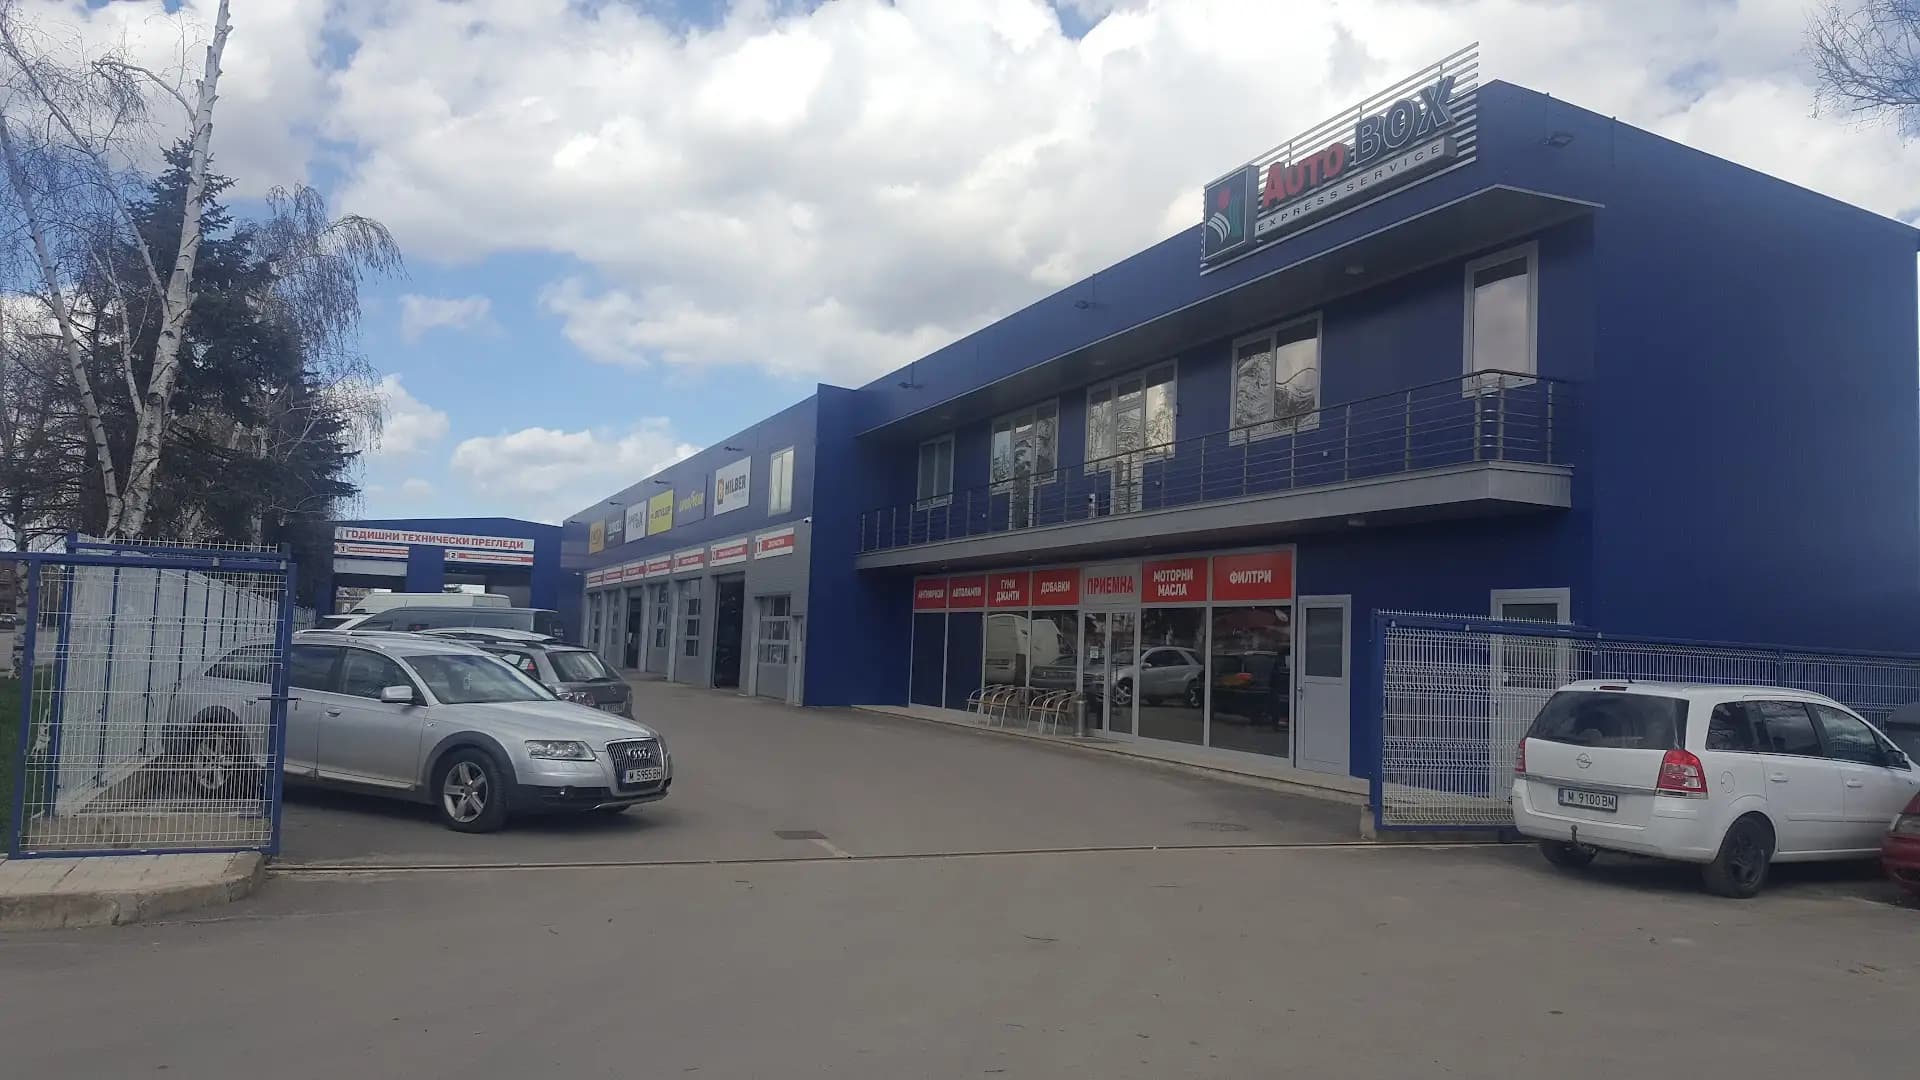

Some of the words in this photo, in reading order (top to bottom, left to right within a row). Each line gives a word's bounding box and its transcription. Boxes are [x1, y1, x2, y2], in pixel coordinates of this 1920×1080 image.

[1354, 75, 1457, 166] BOX
[1257, 190, 1338, 232] EXPRESS
[1346, 143, 1441, 192] SERVICE
[345, 529, 400, 541] ГОДИШНИ
[401, 533, 470, 546] ТЕХНИЧЕСКИ
[471, 538, 524, 549] ПРЕГЛЕДИ
[1153, 568, 1193, 582] МОТОРНИ
[1229, 569, 1272, 584] ФИЛТРИ
[1001, 579, 1016, 590] ГУМИ
[1040, 581, 1070, 595] ДОБАВКИ
[1087, 575, 1134, 595] ПРИЕМНА
[1158, 583, 1187, 596] МАСЛА
[996, 590, 1020, 603] ДЖАНТИ
